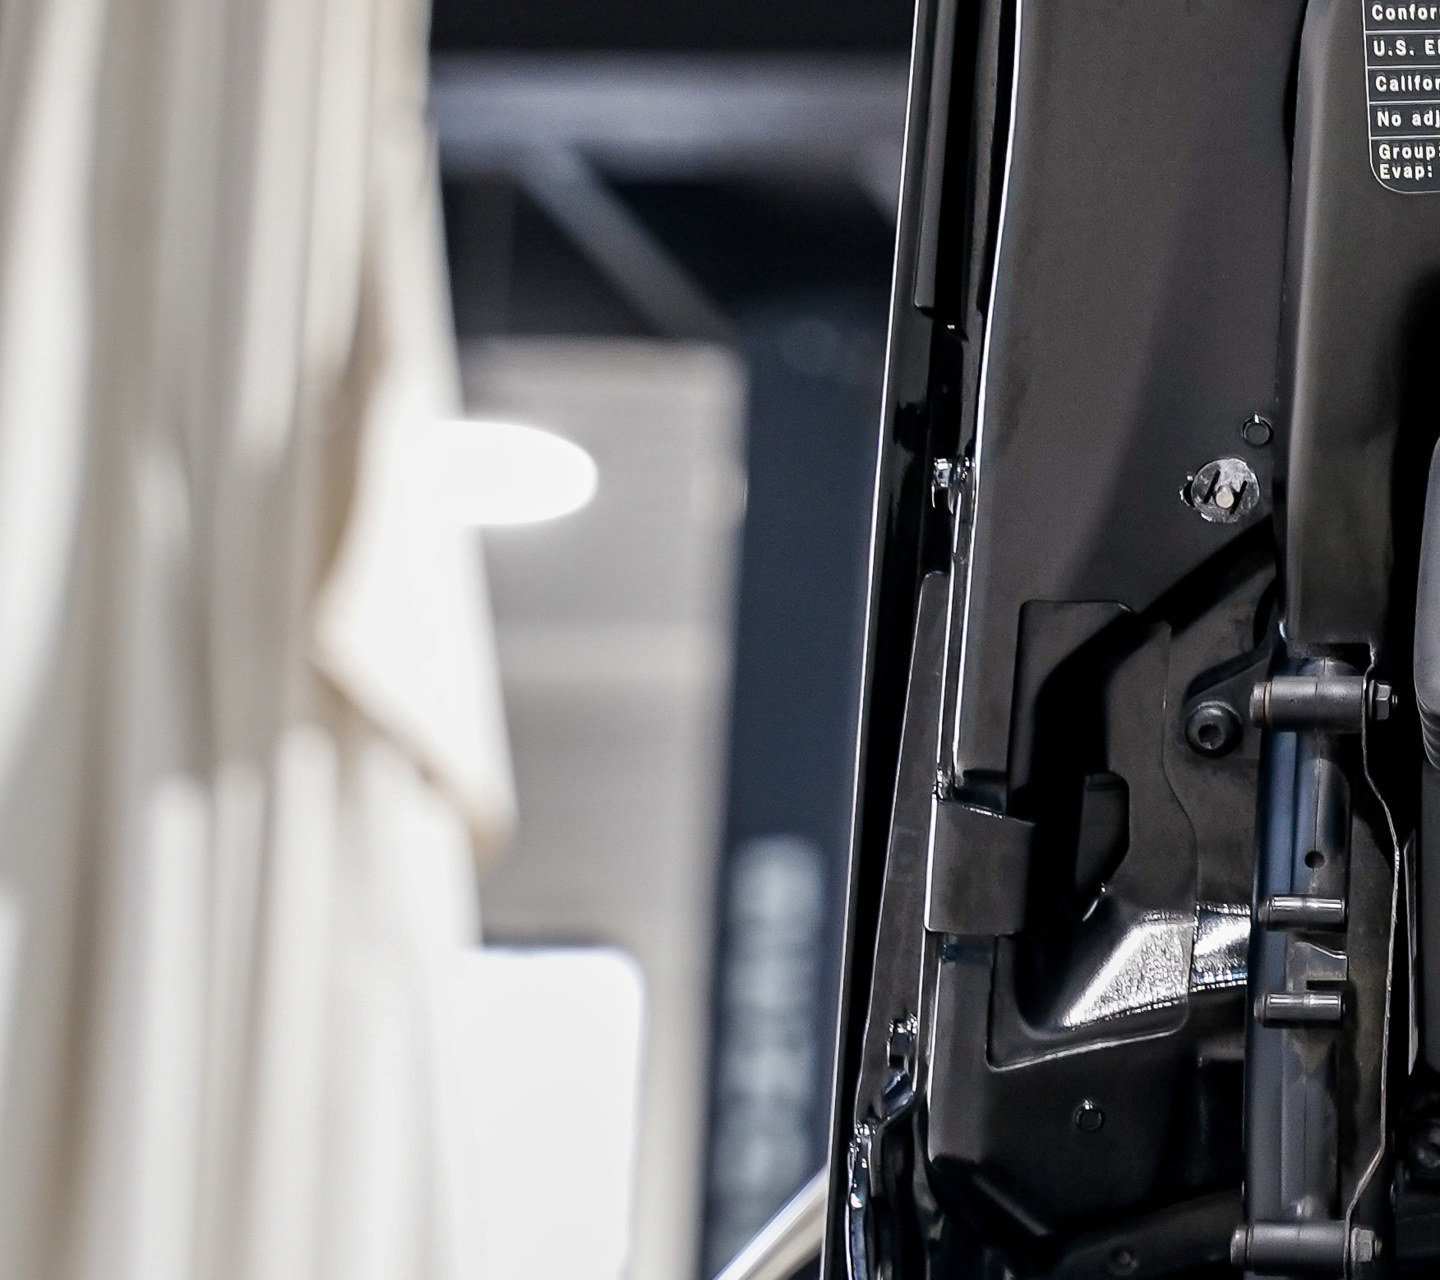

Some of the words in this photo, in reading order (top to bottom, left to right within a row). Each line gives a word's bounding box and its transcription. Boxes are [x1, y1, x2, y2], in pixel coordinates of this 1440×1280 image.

[1373, 39, 1414, 56] U.S.
[1377, 111, 1401, 127] No
[1379, 164, 1432, 181] Evap:
